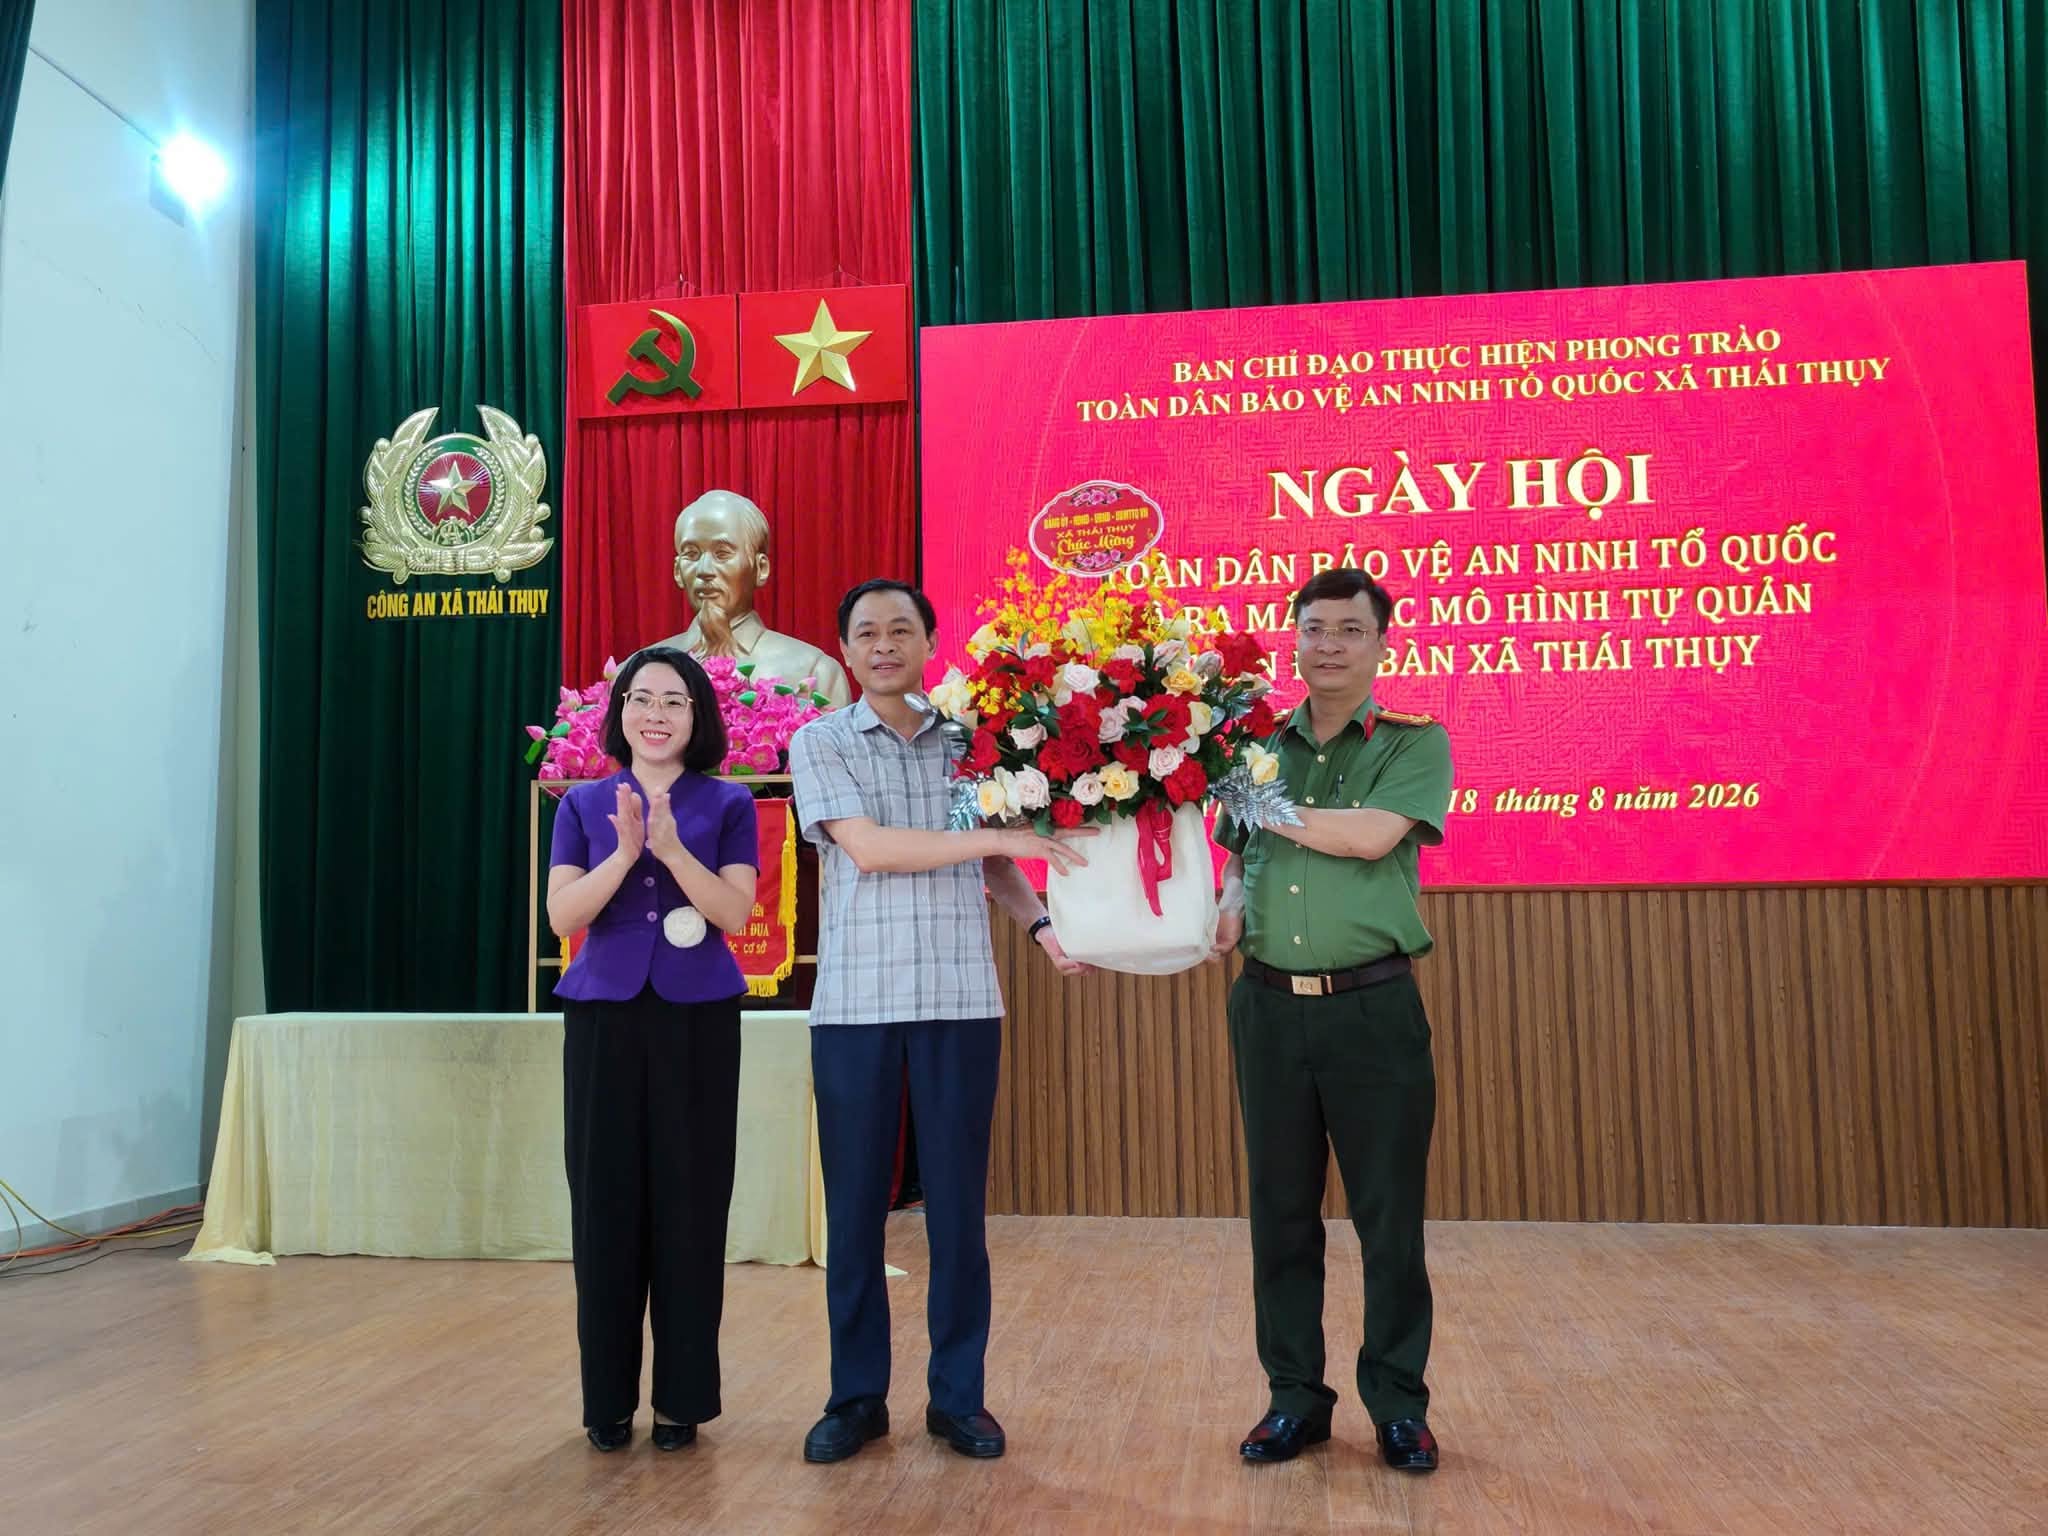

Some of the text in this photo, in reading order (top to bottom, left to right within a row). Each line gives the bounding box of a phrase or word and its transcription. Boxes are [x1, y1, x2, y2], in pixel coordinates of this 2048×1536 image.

[1173, 325, 1782, 384] BAN CHỈ ĐẠO THỰC HIỆN PHONG TRÀO
[1077, 357, 1891, 422] TOÀN DÂN BẢO VỆ AN NINH TỔ QUỐC XÃ THÁI THỤY
[1267, 448, 1656, 521] NGÀY HỘI
[1217, 548, 1297, 585] DÂN
[1311, 543, 1390, 580] BẢO
[1401, 540, 1453, 584] VỆ
[1464, 545, 1520, 576] AN
[1534, 540, 1640, 573] NINH
[1652, 527, 1707, 569] TỔ
[1721, 523, 1837, 572] QUỐC
[367, 585, 549, 619] CÔNG AN XÃ THÁI THỤY
[1183, 604, 1234, 634] RA
[1430, 587, 1491, 626] MÔ
[1506, 585, 1610, 623] HÌNH
[1623, 587, 1684, 625] TỰ
[1696, 575, 1812, 625] QUẢN
[1376, 632, 1760, 677] BÀN XÃ THÁI THỤY
[1447, 783, 1760, 817] 18 tháng 8 năm 2026
